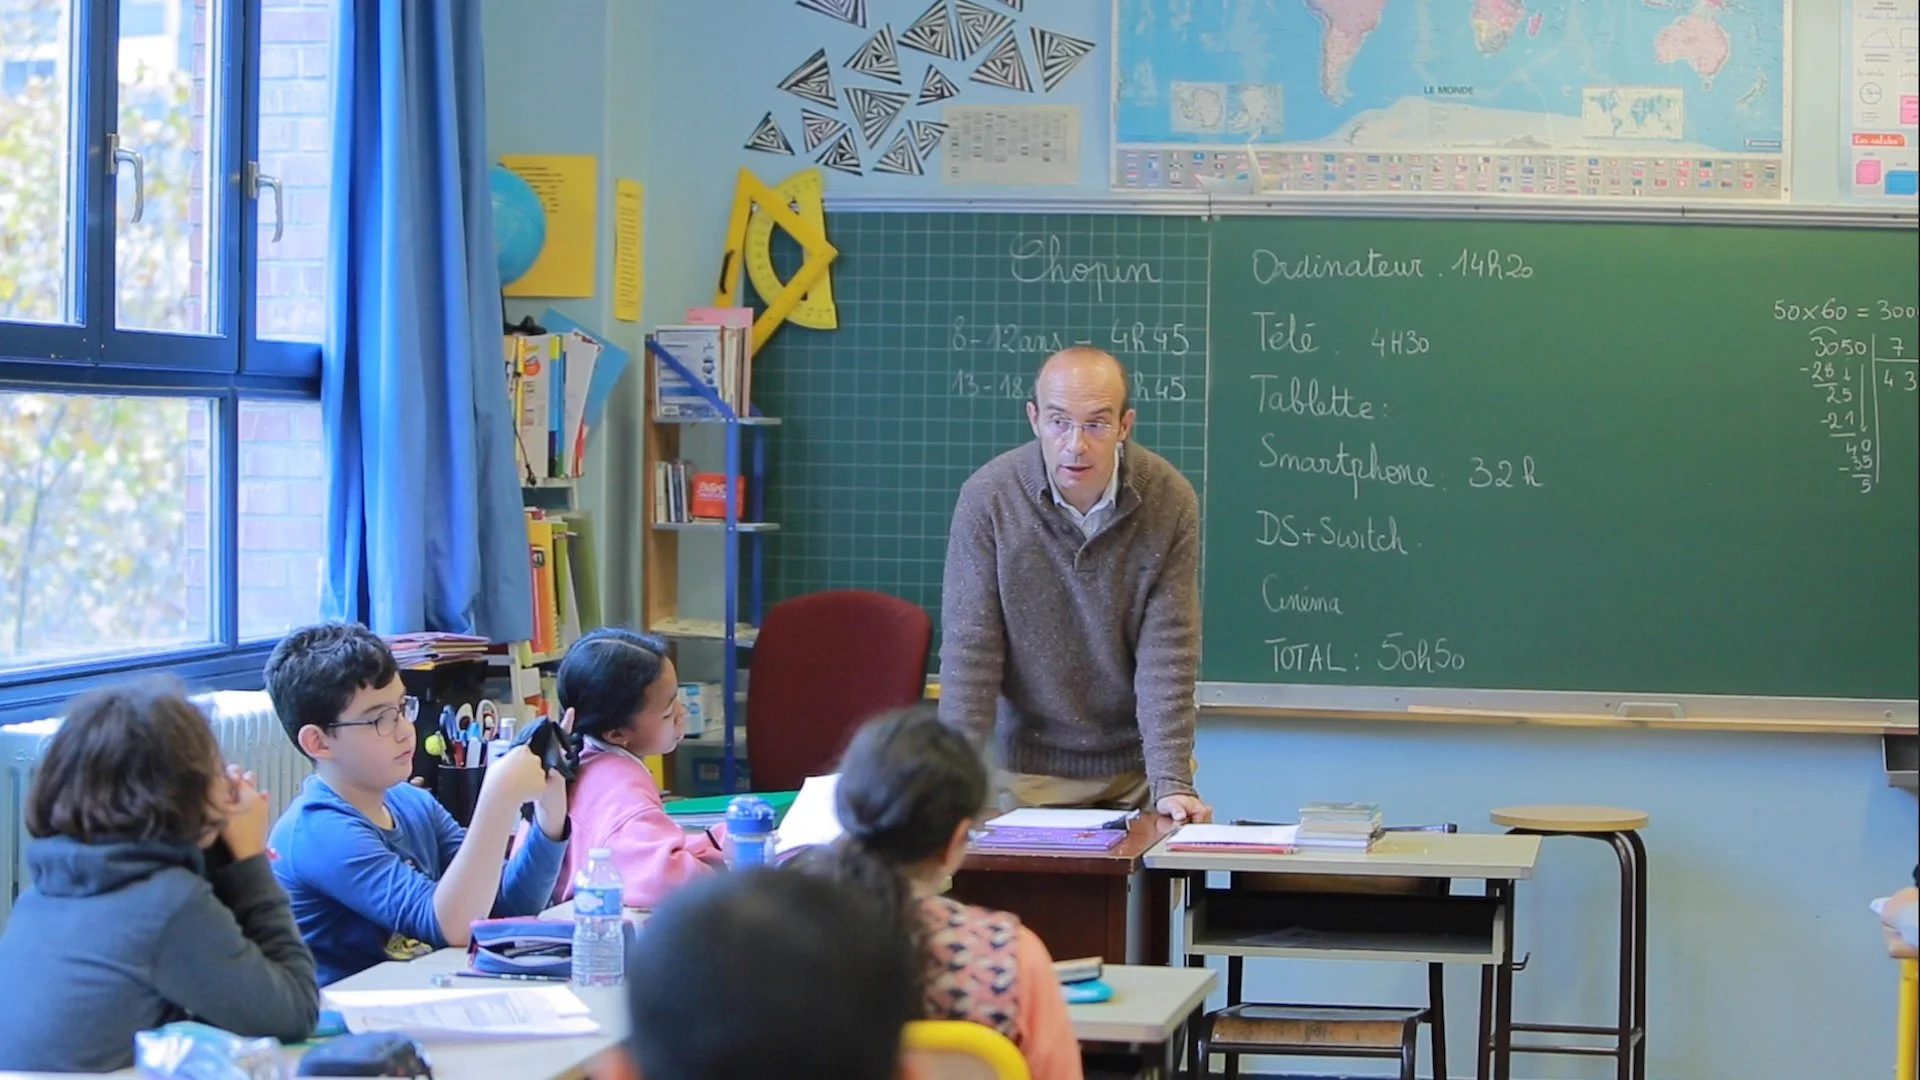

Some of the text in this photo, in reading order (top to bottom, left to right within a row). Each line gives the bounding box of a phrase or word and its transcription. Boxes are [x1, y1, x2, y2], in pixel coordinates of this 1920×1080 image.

[1423, 86, 1475, 96] LE MONDE
[1009, 234, 1161, 302] Chopin
[1252, 248, 1424, 284] Ordinateur
[1451, 248, 1534, 280] 14h20
[1877, 300, 1919, 320] 300
[1252, 311, 1319, 353] Télé
[1371, 327, 1430, 357] 4H30
[1811, 336, 1867, 357] 3050
[1889, 336, 1905, 356] 7
[1377, 632, 1464, 673] 50h50
